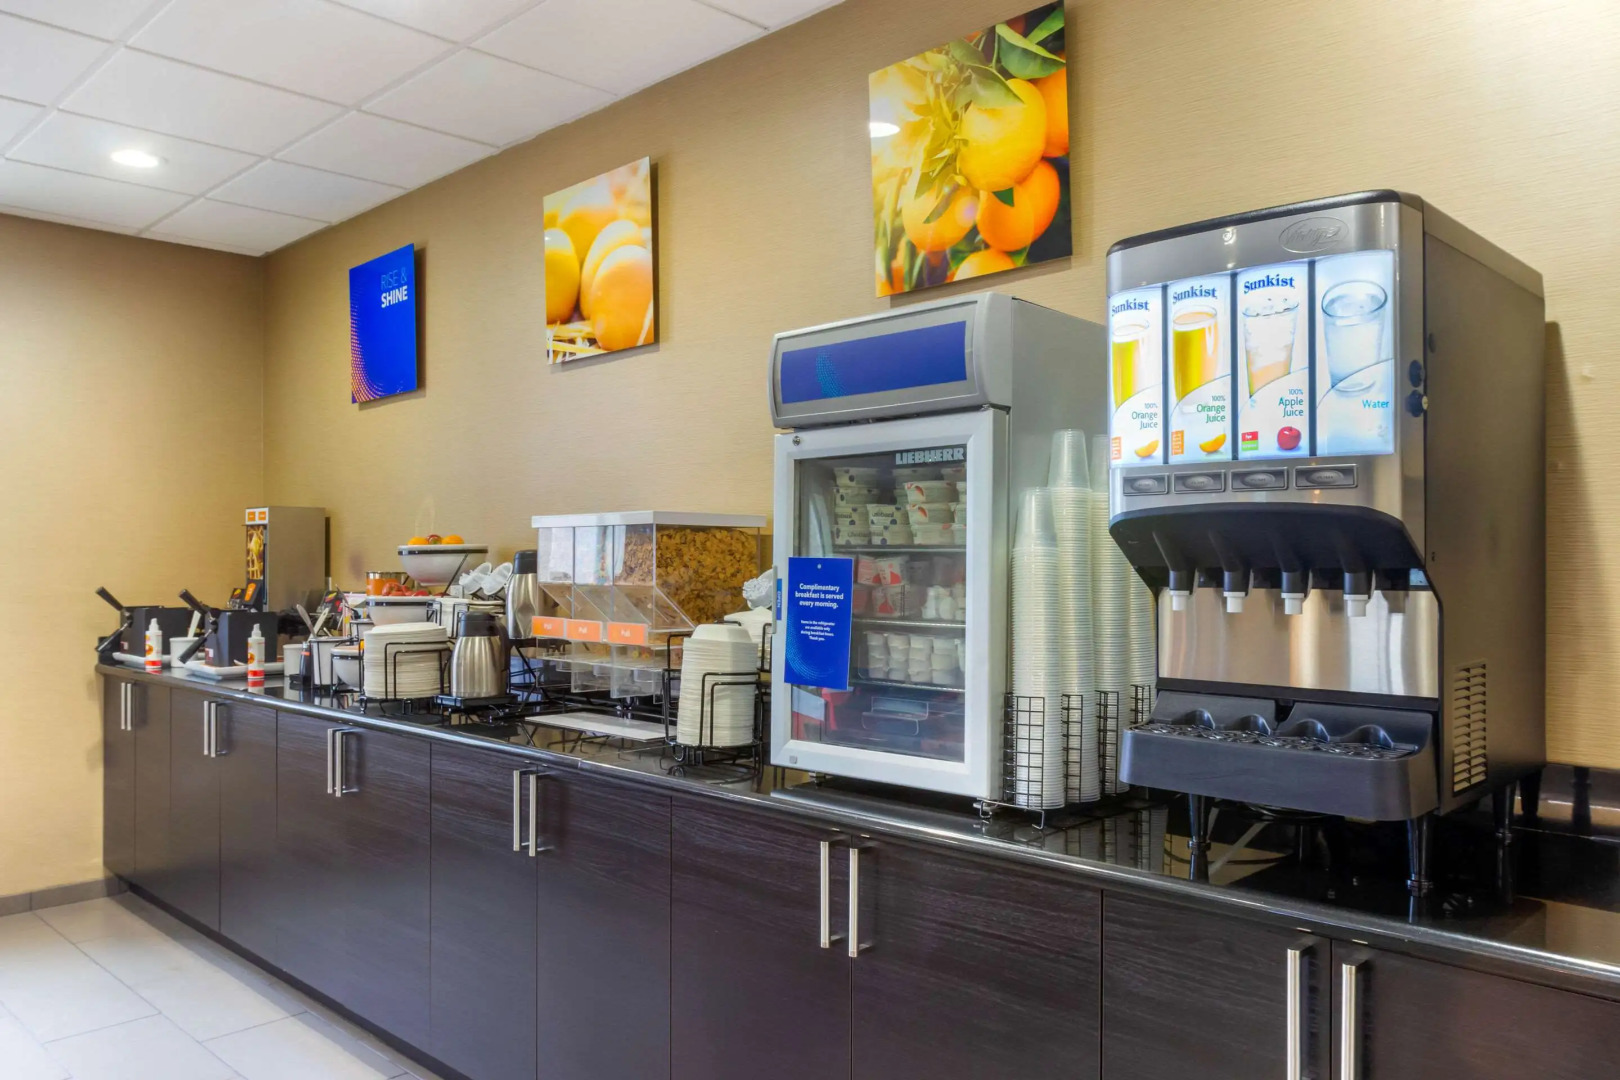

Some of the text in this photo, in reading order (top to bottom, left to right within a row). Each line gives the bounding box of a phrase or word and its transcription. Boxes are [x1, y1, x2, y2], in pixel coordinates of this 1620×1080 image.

[381, 267, 407, 291] RISE &
[1244, 274, 1295, 294] Sunkist
[381, 285, 408, 308] SHINE
[1173, 285, 1217, 304] Sunkist
[1111, 298, 1150, 316] Sunkist
[1278, 397, 1304, 408] Apple
[1362, 399, 1390, 409] Water
[1196, 403, 1226, 414] Orange
[1283, 407, 1304, 417] Juice
[1131, 411, 1158, 421] Orange
[1206, 413, 1226, 423] Juice
[1140, 420, 1158, 430] Juice
[895, 448, 965, 465] LIEBHERR
[799, 583, 840, 593] Complimentary
[795, 591, 819, 599] breakfast
[799, 600, 839, 609] every morning.
